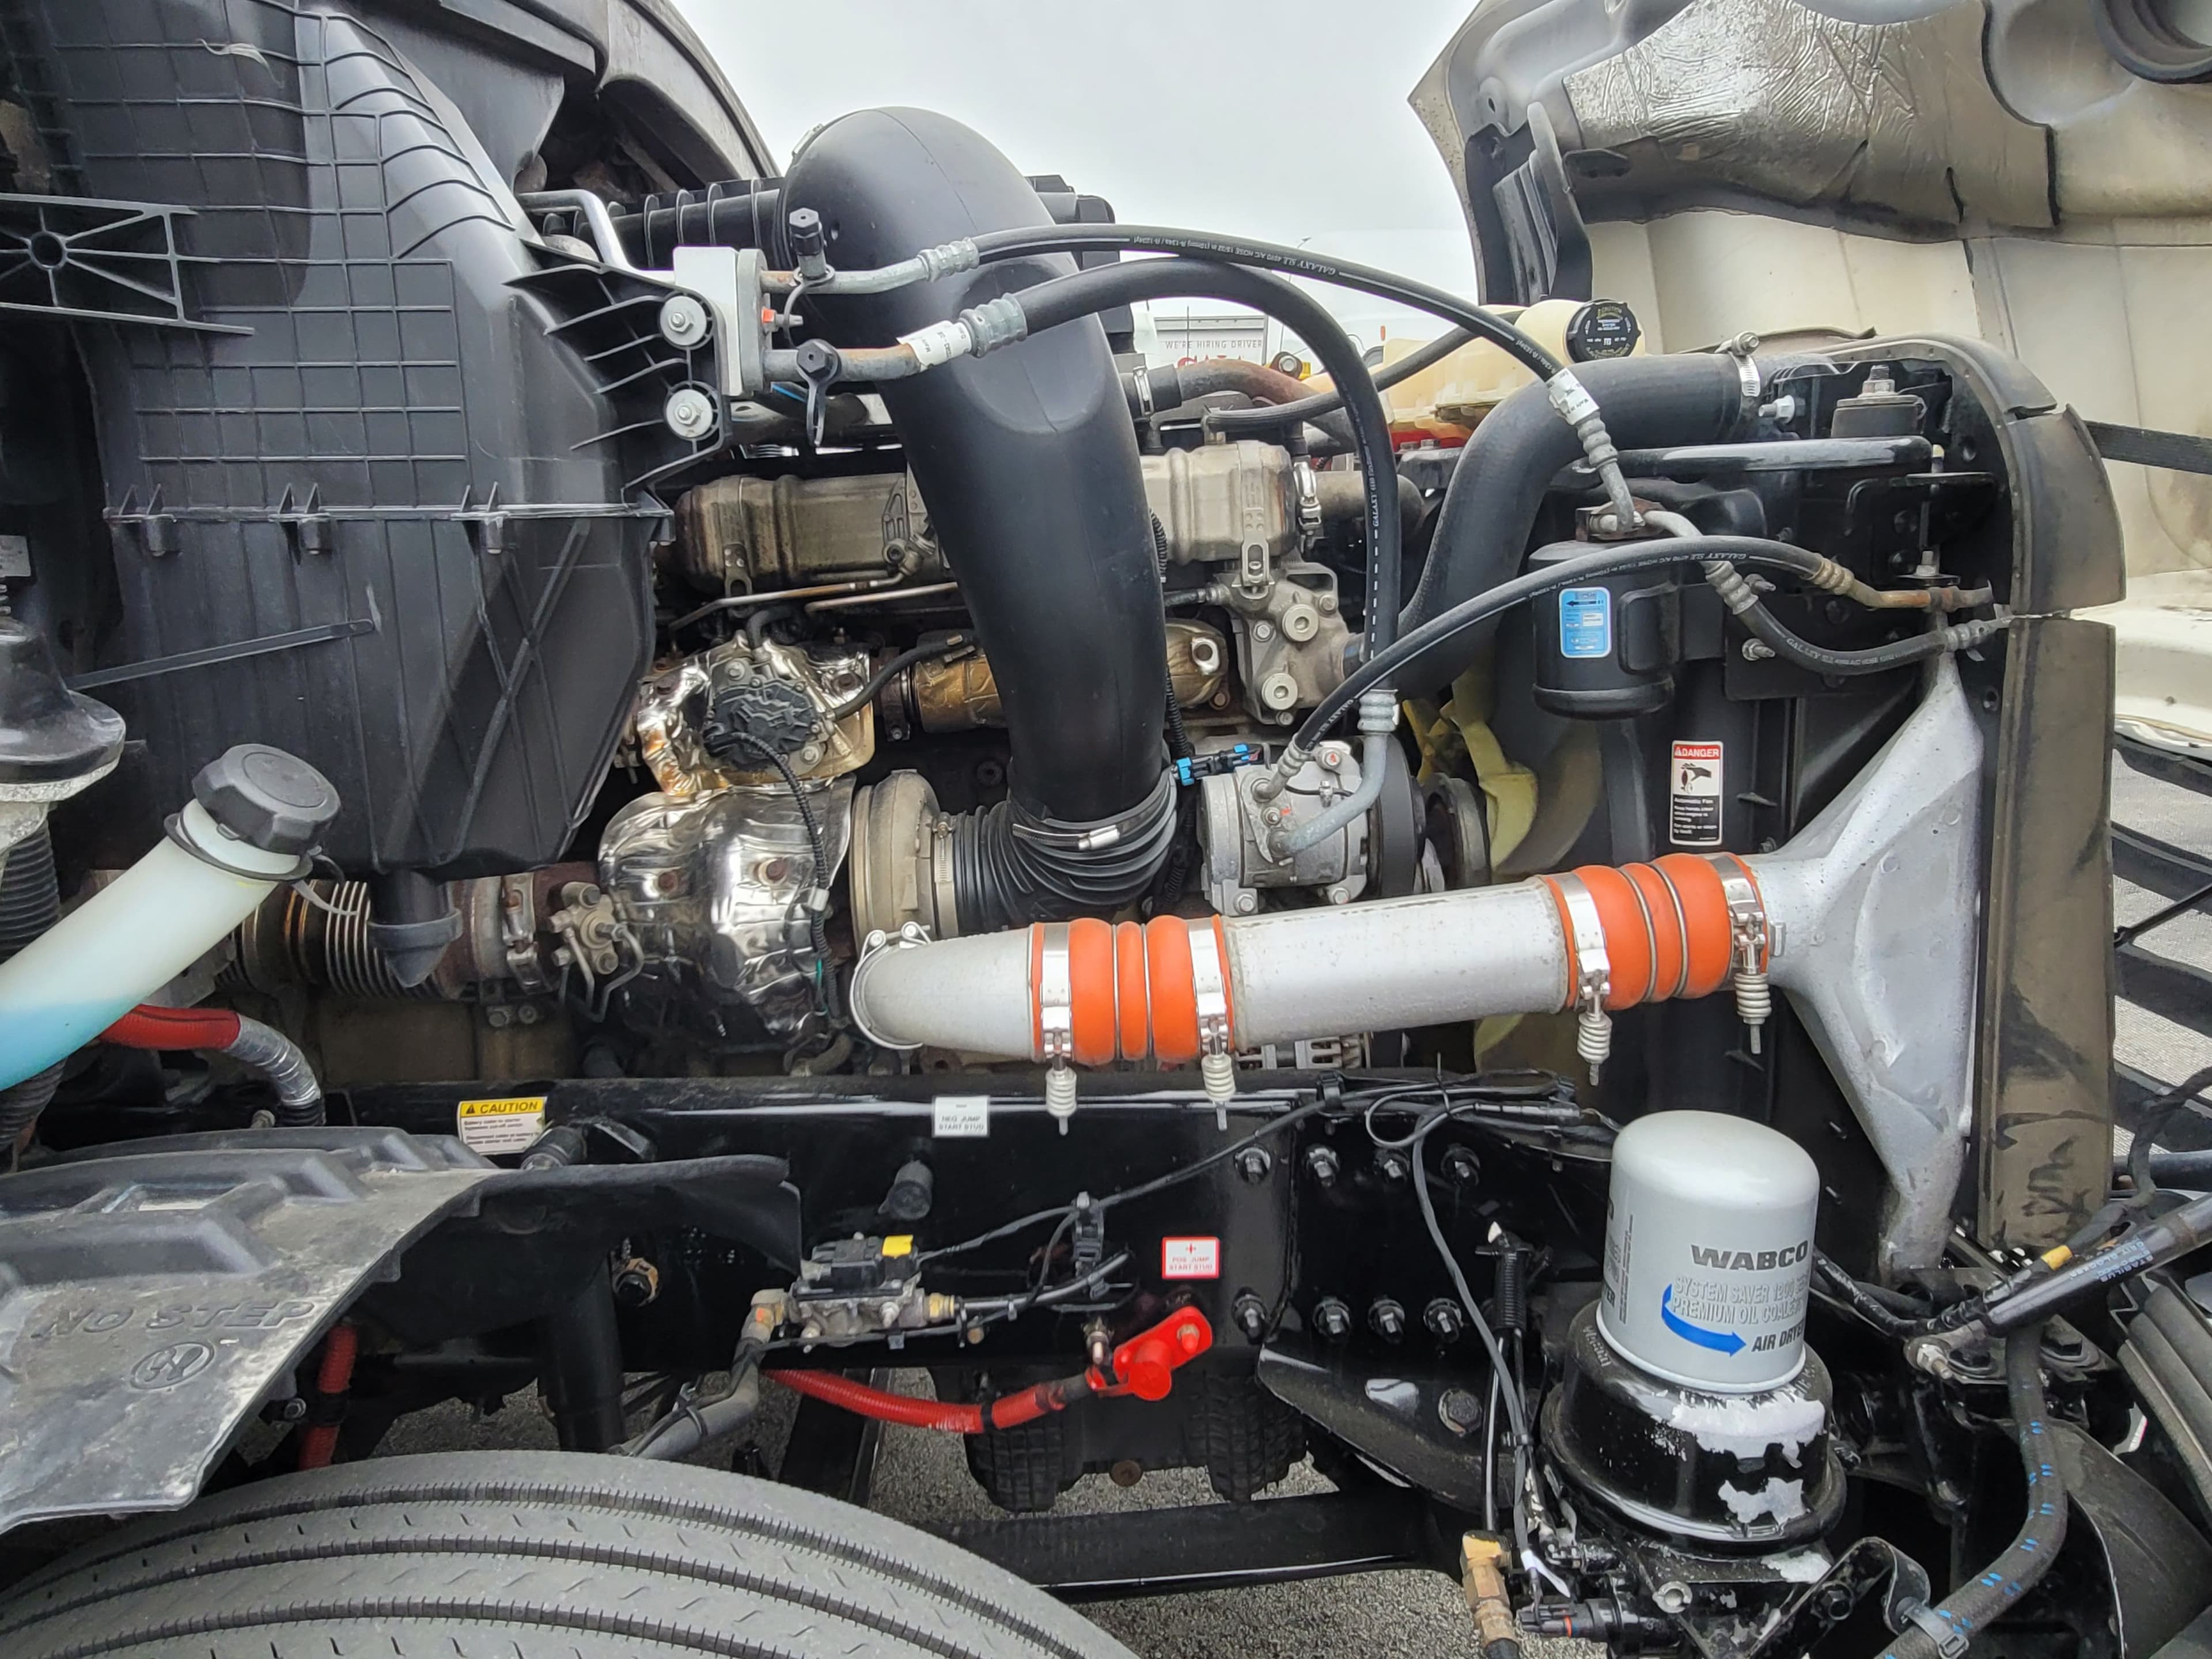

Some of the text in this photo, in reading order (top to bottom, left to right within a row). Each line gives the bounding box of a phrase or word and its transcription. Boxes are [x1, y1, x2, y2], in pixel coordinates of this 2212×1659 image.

[1297, 260, 1336, 275] GALAXY
[1165, 341, 1192, 350] WE'RE
[1197, 340, 1227, 349] HIRING
[1682, 749, 1719, 757] DANGER
[480, 1101, 538, 1113] CAUTION
[1690, 1240, 1809, 1271] WABCO
[1675, 1275, 1728, 1303] SYSTEM
[1731, 1282, 1770, 1305] SAVER
[30, 1297, 315, 1339] NO STEP
[1672, 1297, 1736, 1325] PREMIUM
[1740, 1306, 1759, 1325] OIL
[1751, 1334, 1777, 1353] AIR
